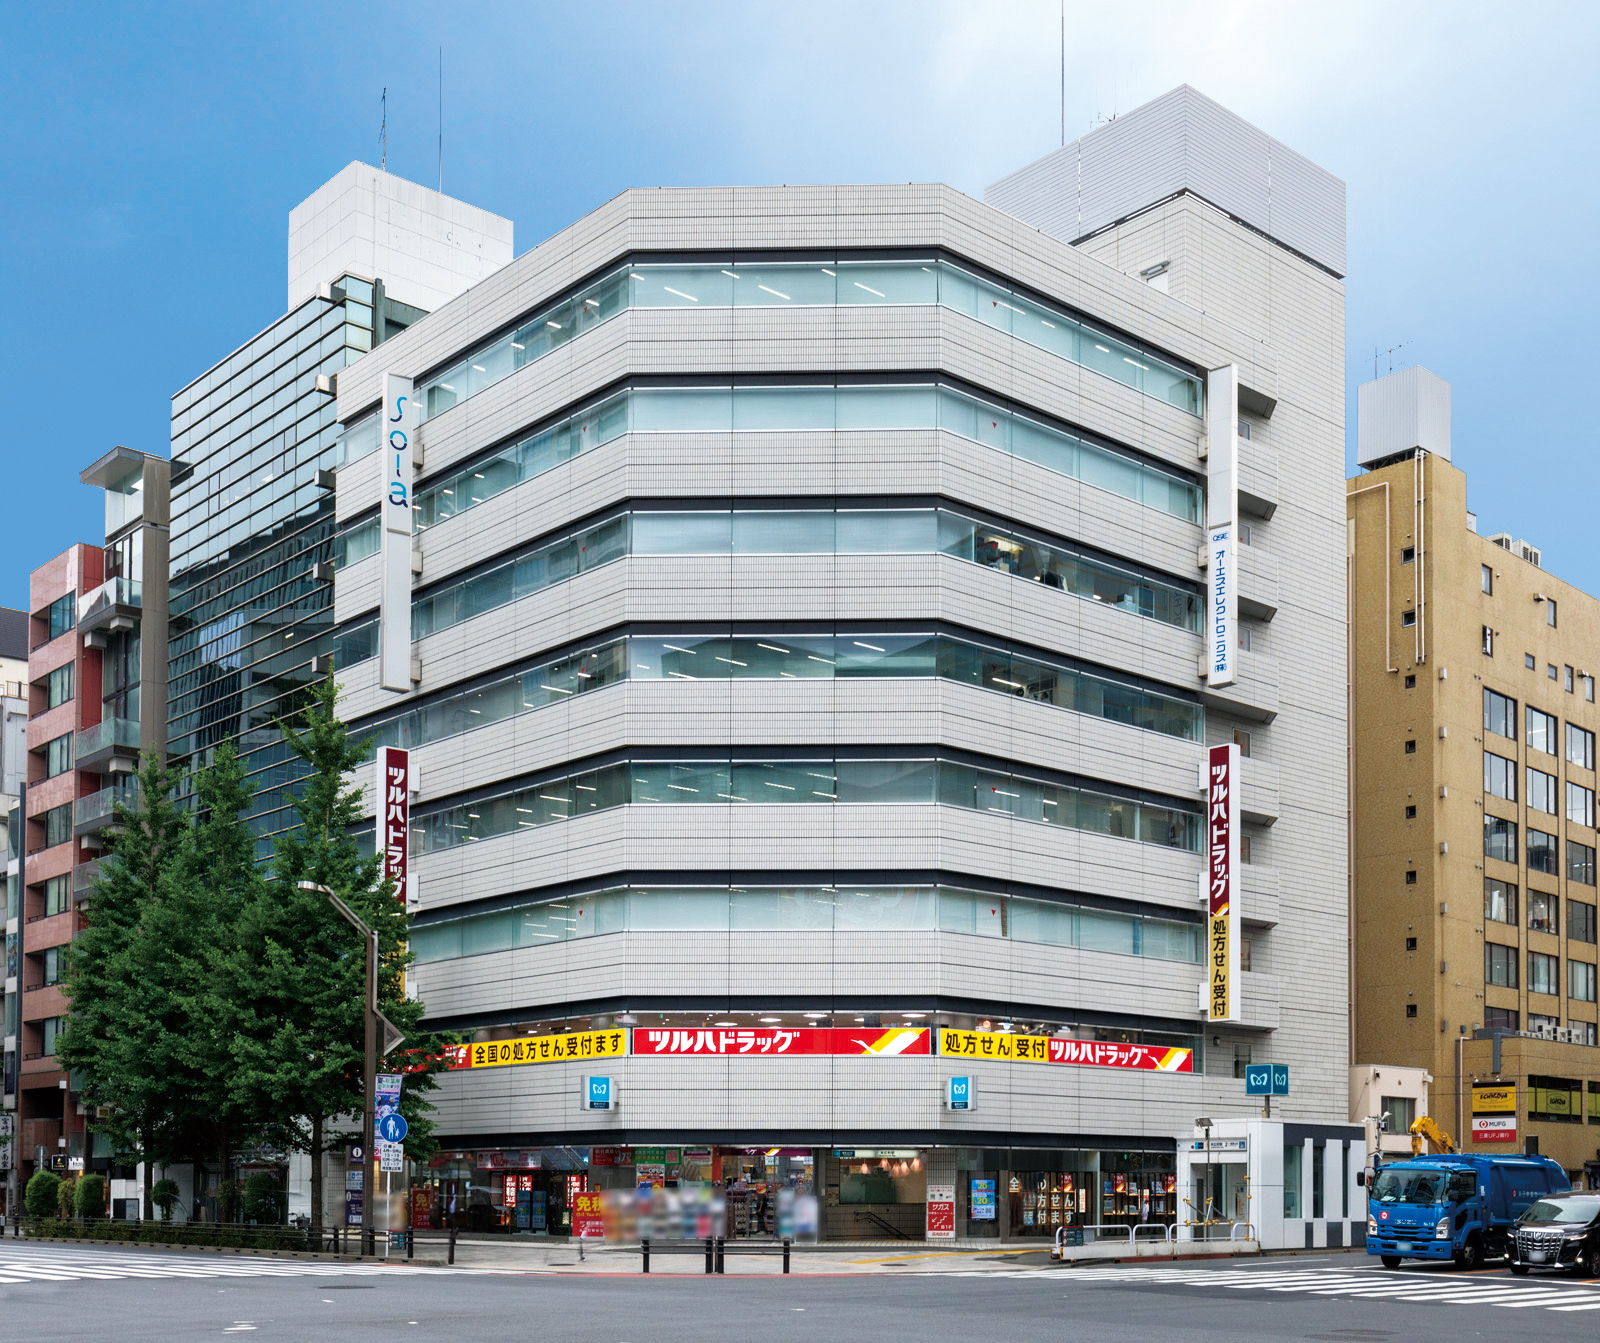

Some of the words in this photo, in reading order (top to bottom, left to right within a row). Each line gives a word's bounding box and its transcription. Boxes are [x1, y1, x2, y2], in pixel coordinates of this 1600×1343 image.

[1211, 764, 1229, 899] ツルハドラッグ
[1213, 919, 1227, 1017] 処方せん受付
[475, 1033, 622, 1063] 全国の処方せん受付ます
[648, 1031, 800, 1053] ツルハドラッグ
[946, 1033, 1046, 1058] 処方せん受付
[1050, 1040, 1149, 1066] ツルハドラッグ
[932, 1203, 949, 1211] サガス
